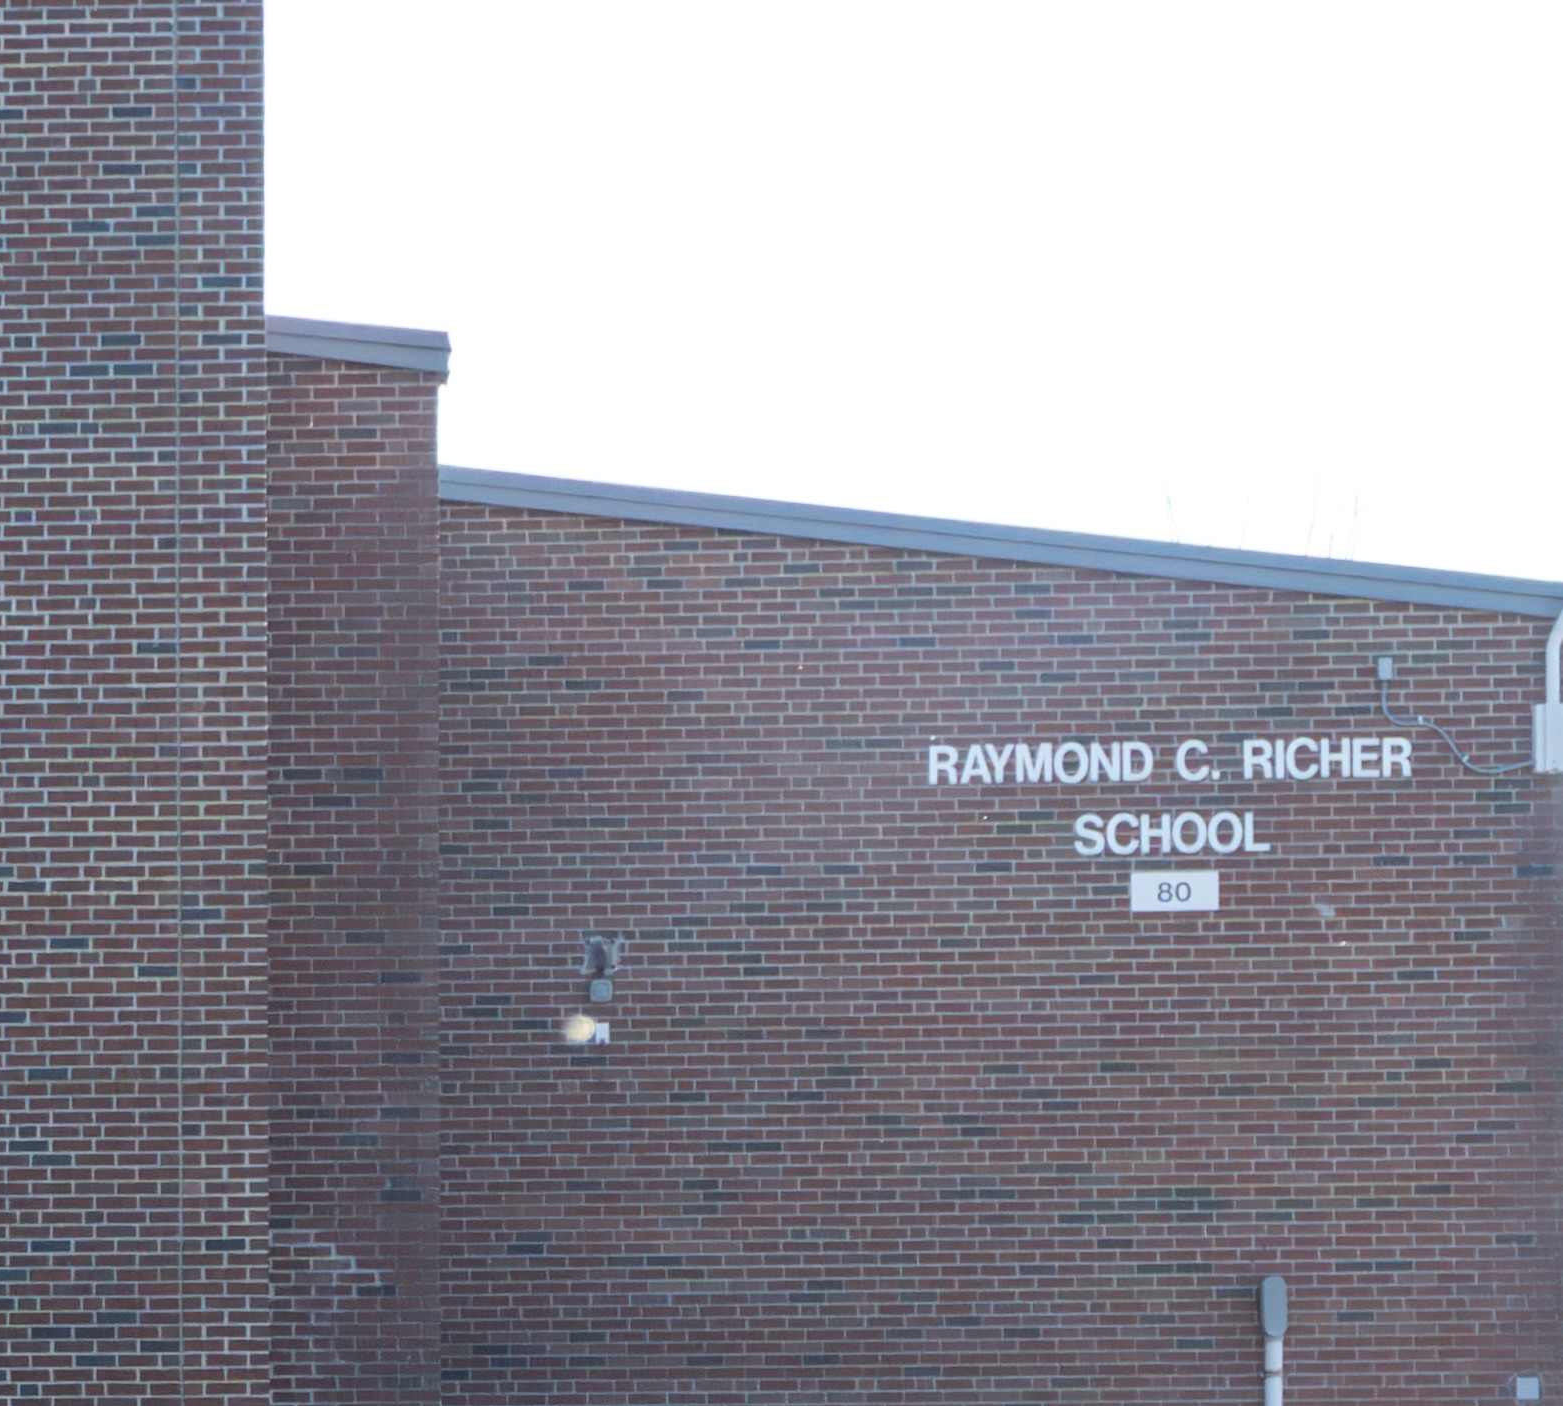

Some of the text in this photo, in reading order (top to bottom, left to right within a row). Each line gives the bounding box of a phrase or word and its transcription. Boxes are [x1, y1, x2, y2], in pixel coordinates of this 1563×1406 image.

[928, 737, 1413, 785] RAYMOND C. RICHER
[1074, 811, 1271, 856] SCHOOL
[1157, 882, 1192, 903] 80
